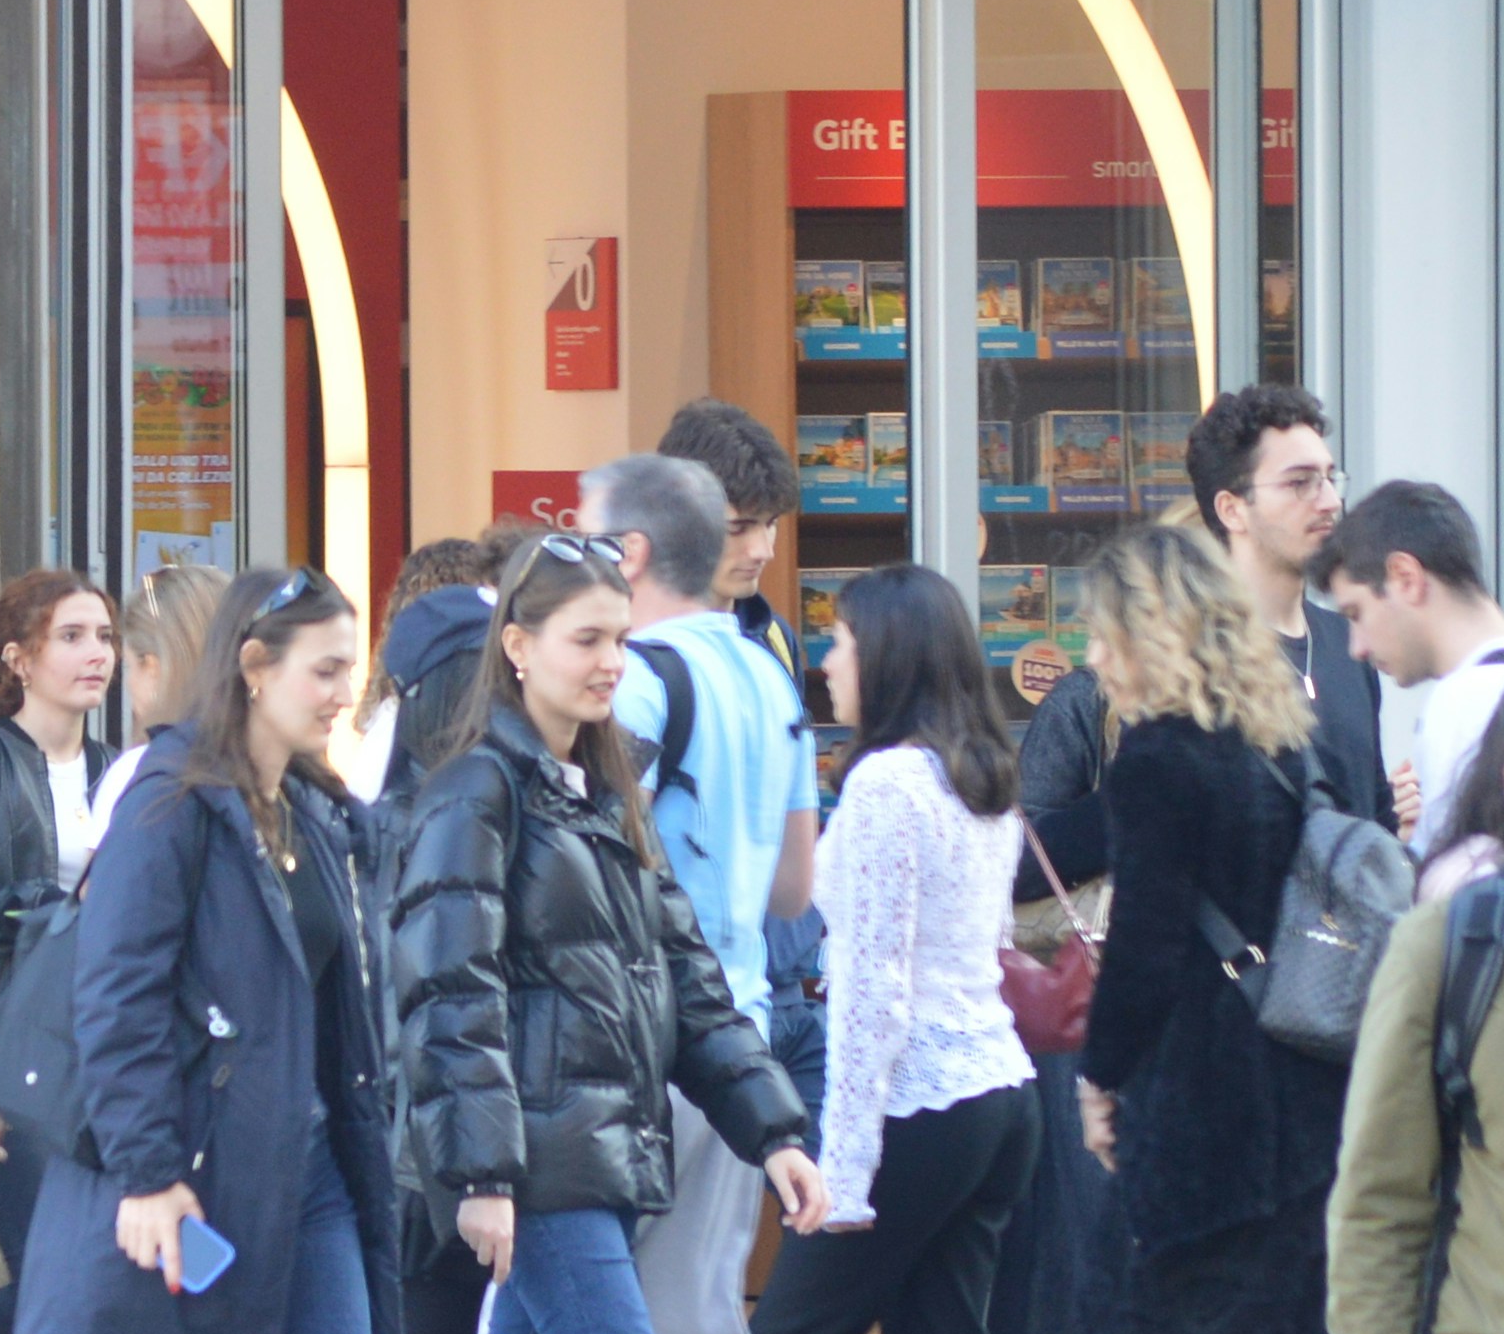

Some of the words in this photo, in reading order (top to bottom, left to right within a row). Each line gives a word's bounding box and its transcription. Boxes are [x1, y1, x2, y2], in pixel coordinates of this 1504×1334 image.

[813, 117, 879, 151] Gift
[1262, 117, 1293, 148] Gi
[1092, 160, 1159, 179] smar
